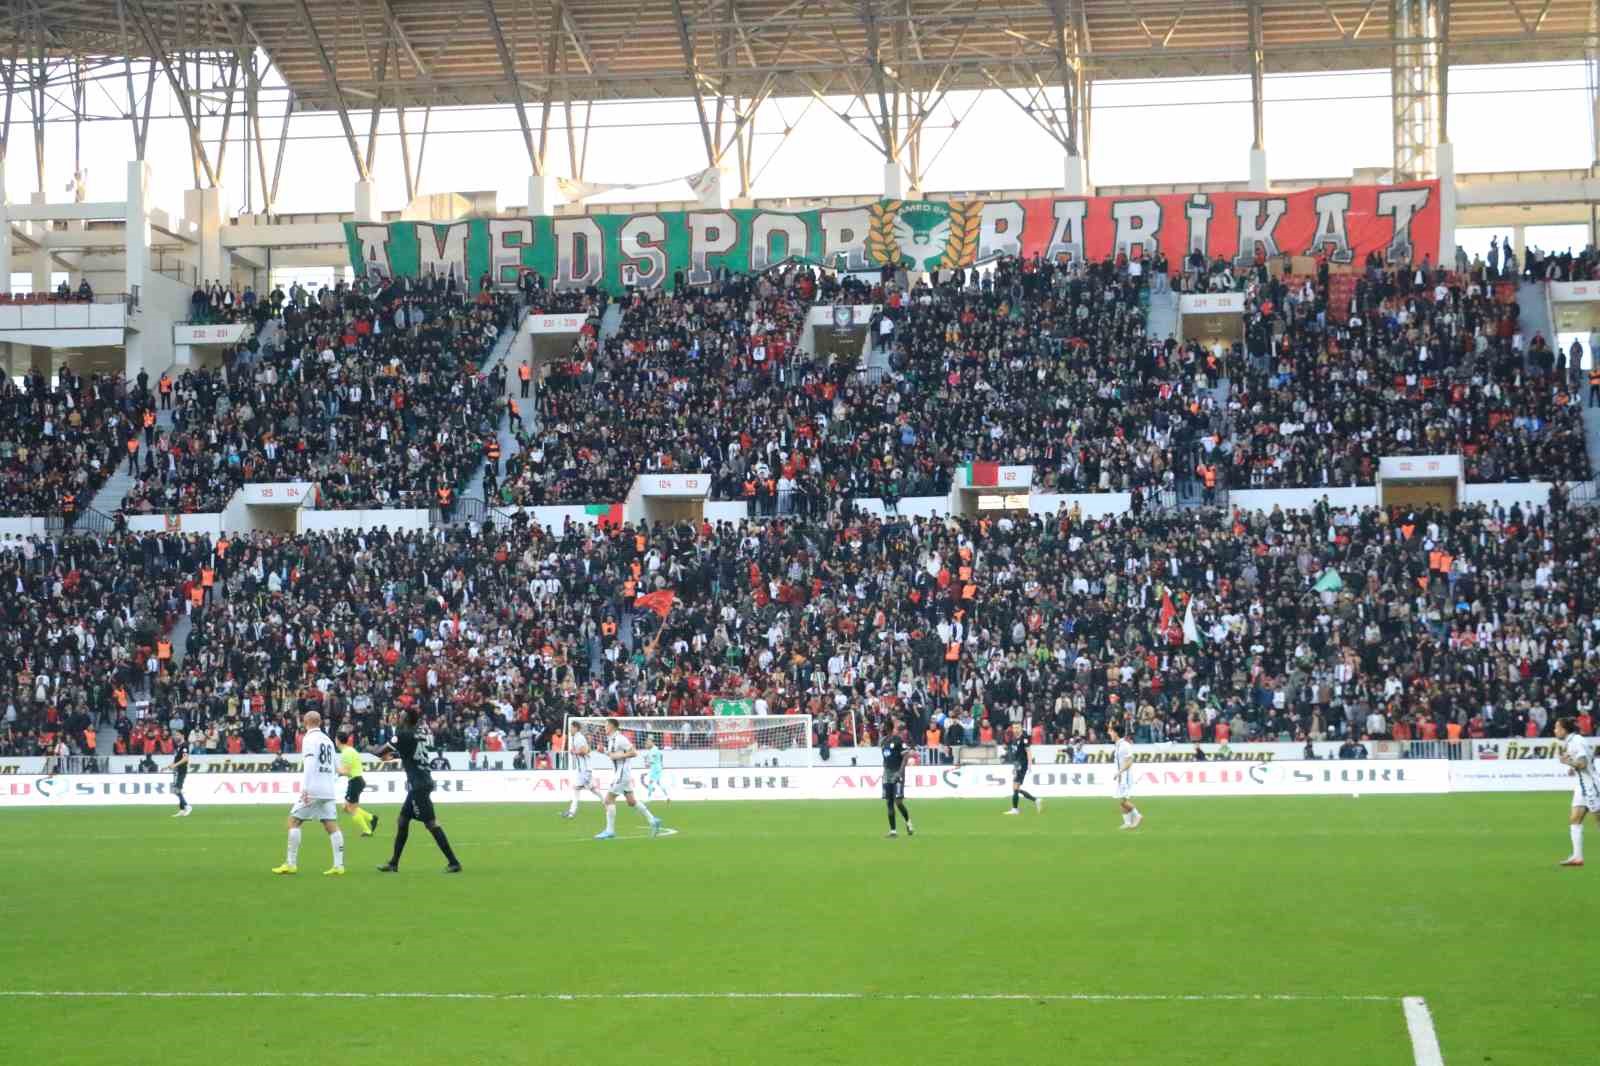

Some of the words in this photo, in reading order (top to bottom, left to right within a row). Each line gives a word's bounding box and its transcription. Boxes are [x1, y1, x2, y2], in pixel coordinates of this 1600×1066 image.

[356, 207, 874, 293] AMEDSPOR
[1004, 472, 1016, 480] 122
[660, 480, 671, 488] 124
[288, 488, 299, 497] 124
[683, 776, 800, 789] STORE
[832, 775, 938, 788] AMD
[985, 772, 1105, 785] SORE
[1136, 770, 1243, 784] AMED
[1293, 769, 1416, 782] STORE
[361, 780, 472, 792] STRE
